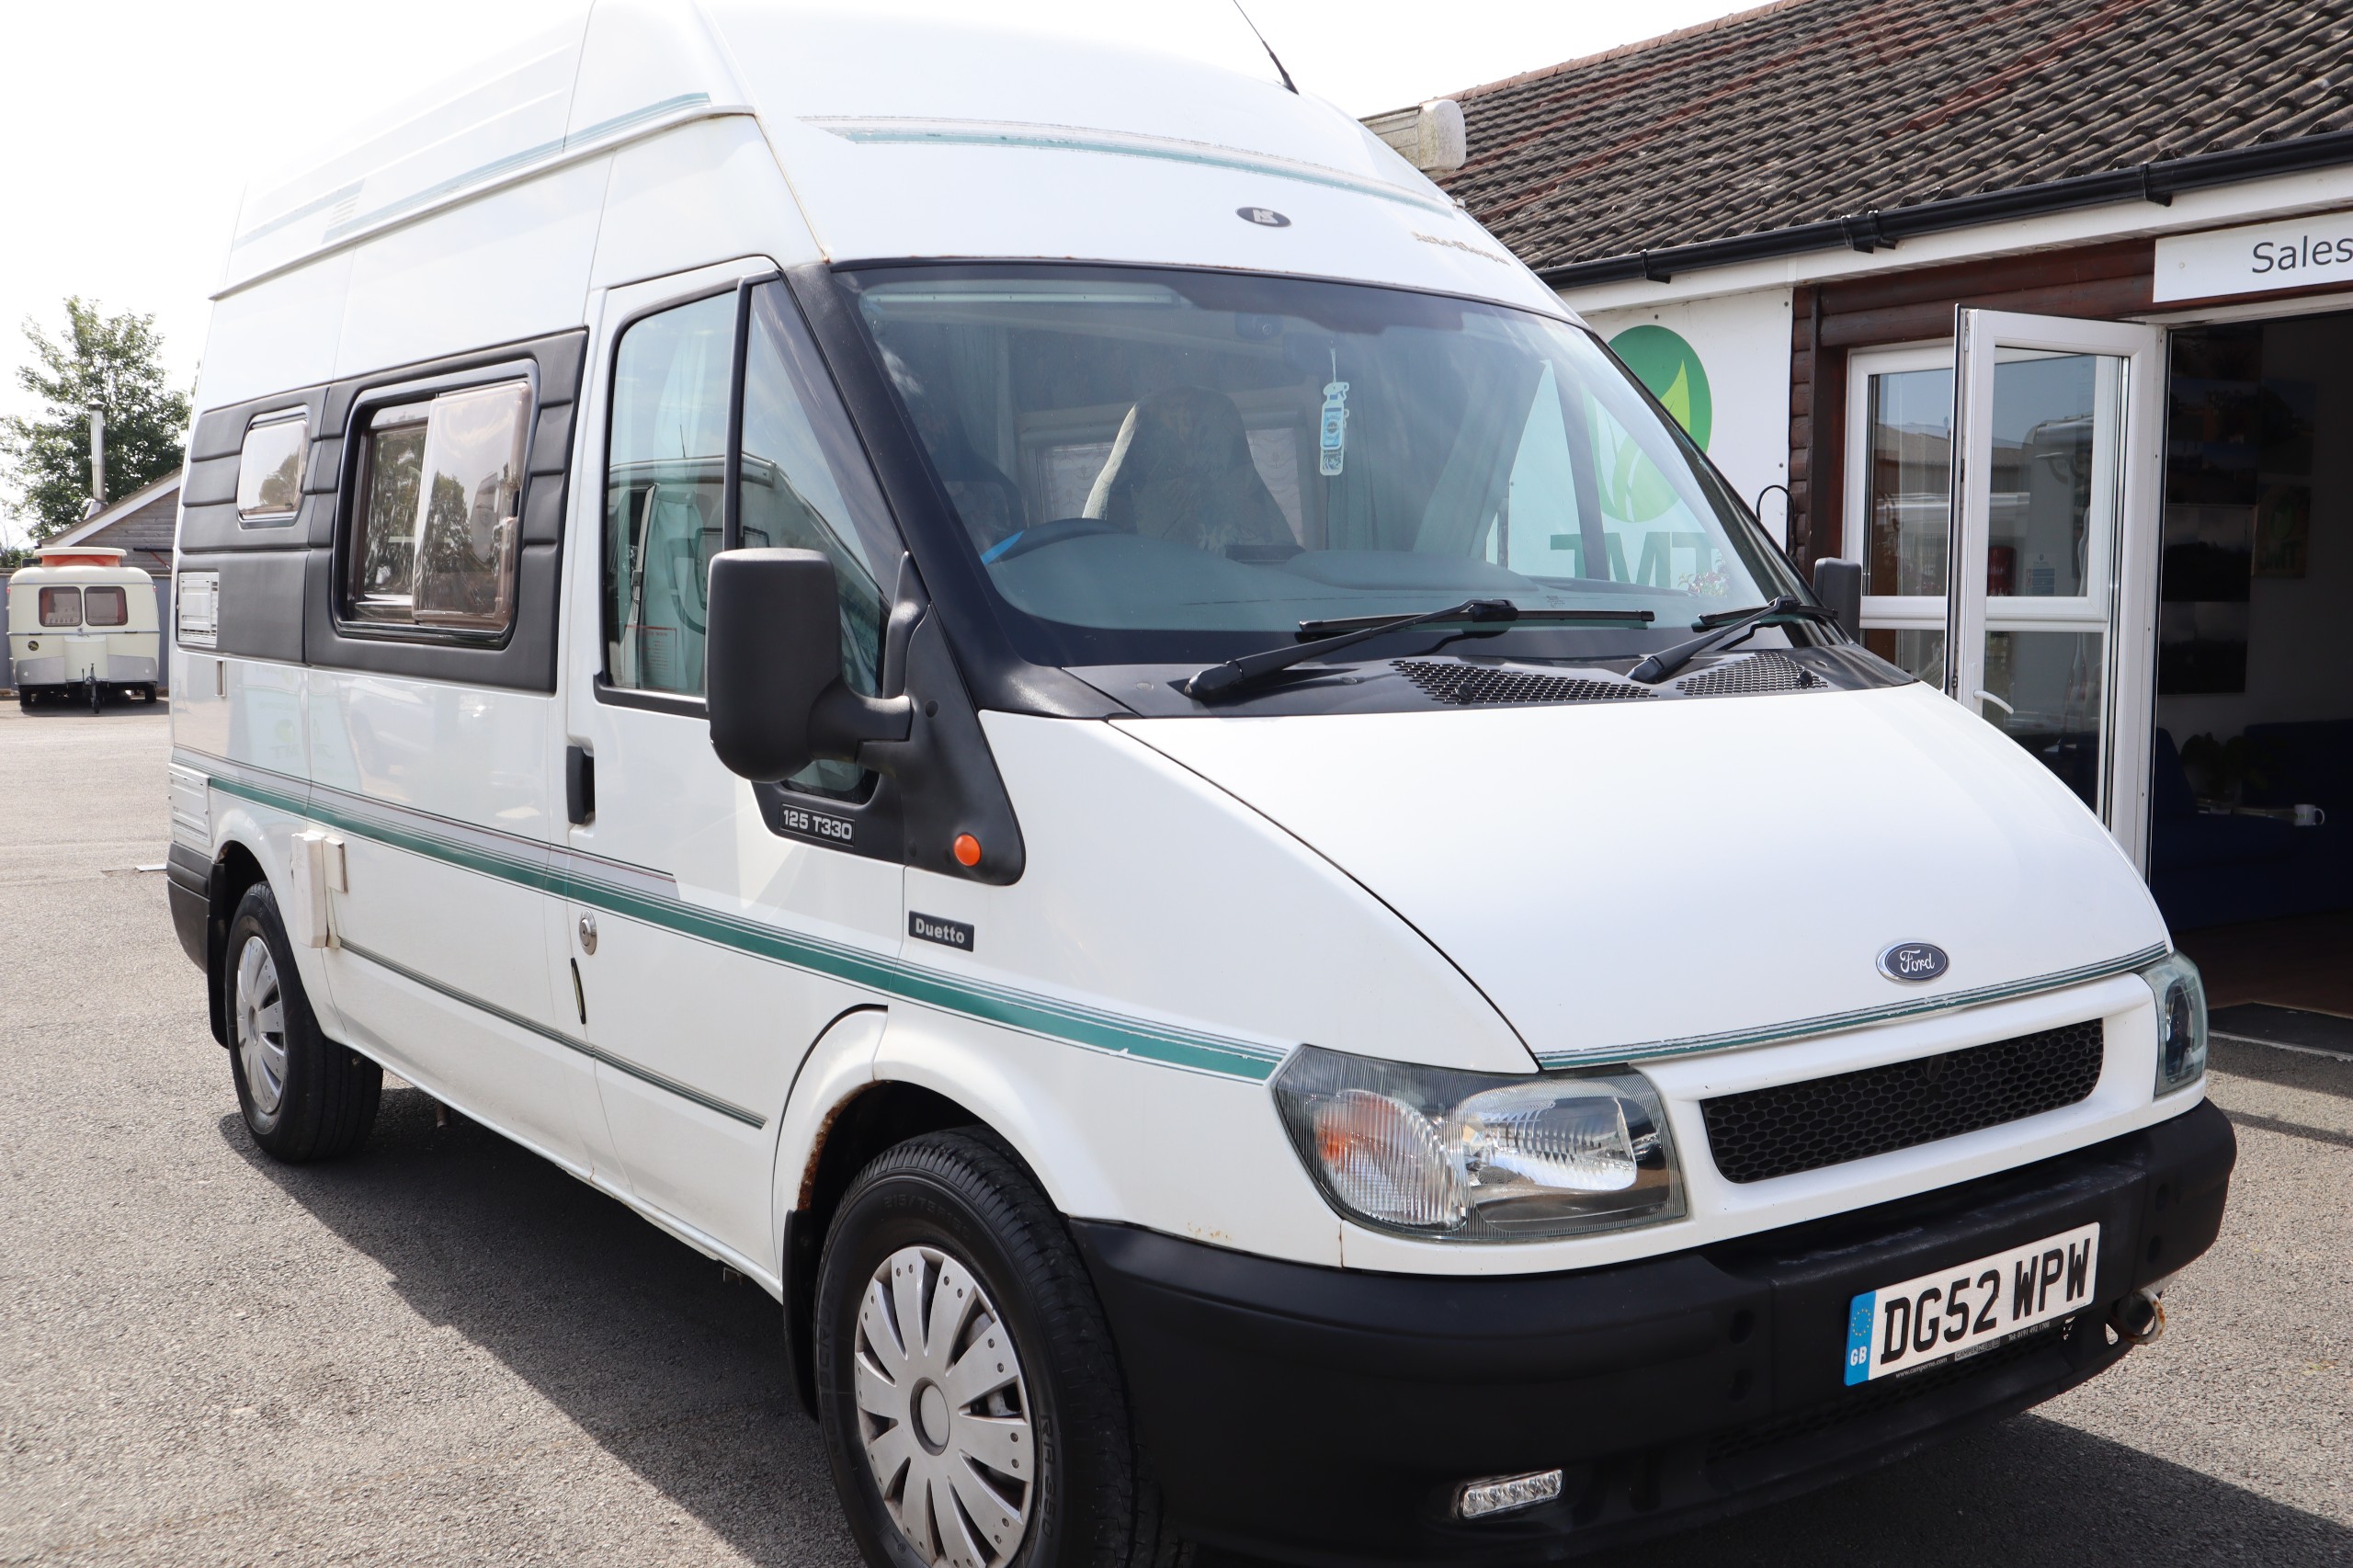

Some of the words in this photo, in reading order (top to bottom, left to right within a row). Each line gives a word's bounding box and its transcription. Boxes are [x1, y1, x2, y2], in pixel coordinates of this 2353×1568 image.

[2252, 235, 2353, 274] Sales
[783, 809, 809, 830] 125
[813, 816, 853, 840] T330
[915, 918, 965, 944] Duetto
[1899, 949, 1936, 973] Ford
[1880, 1268, 2001, 1366] DG52
[2012, 1237, 2091, 1323] WPW
[1850, 1346, 1868, 1367] GB
